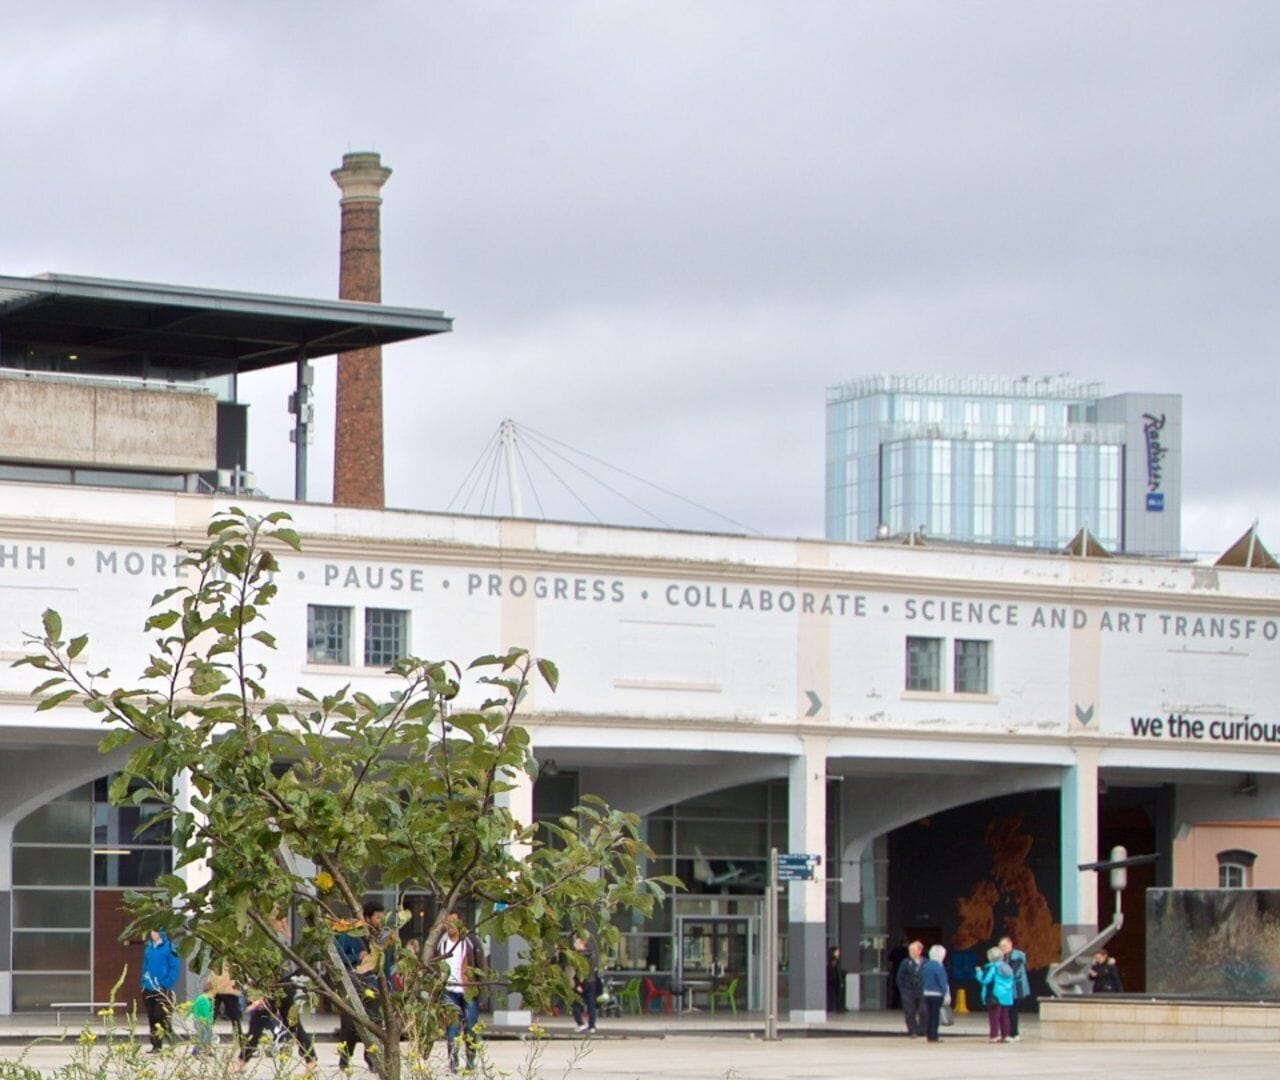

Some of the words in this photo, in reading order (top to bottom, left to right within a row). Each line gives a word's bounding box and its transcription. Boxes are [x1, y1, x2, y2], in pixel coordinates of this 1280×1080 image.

[96, 550, 189, 577] MORE
[325, 564, 424, 591] PAUSE
[468, 573, 624, 602] PROGRESS
[665, 584, 867, 616] COLLABORATE
[905, 599, 1018, 626] SCIENCE
[1032, 607, 1088, 629] AND
[1100, 611, 1146, 633] ART
[1160, 615, 1278, 641] TRANSFO
[1131, 717, 1163, 737] we
[1168, 714, 1204, 739] the
